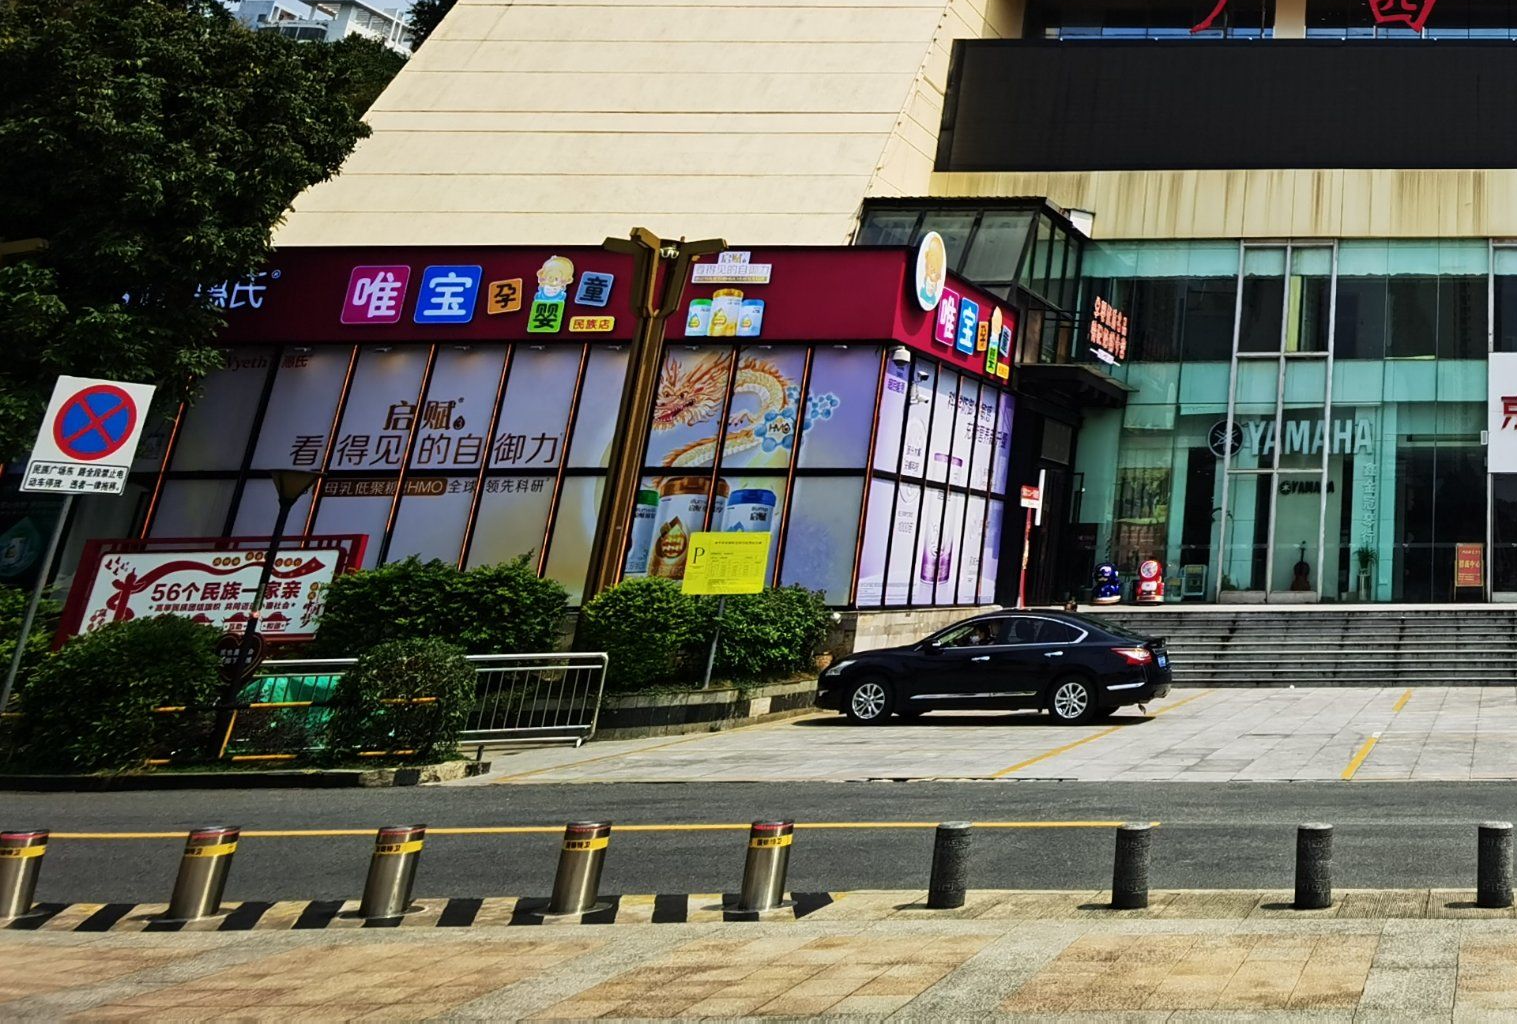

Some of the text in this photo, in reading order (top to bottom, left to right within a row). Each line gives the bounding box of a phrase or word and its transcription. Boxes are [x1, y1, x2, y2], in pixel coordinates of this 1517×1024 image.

[573, 319, 609, 330] 民族店
[1249, 419, 1373, 455] YAMAHA
[289, 432, 558, 466] 看得见的自御力
[1291, 480, 1335, 494] YAMAA
[693, 547, 705, 564] P
[150, 581, 301, 602] 56个民族一家亲
